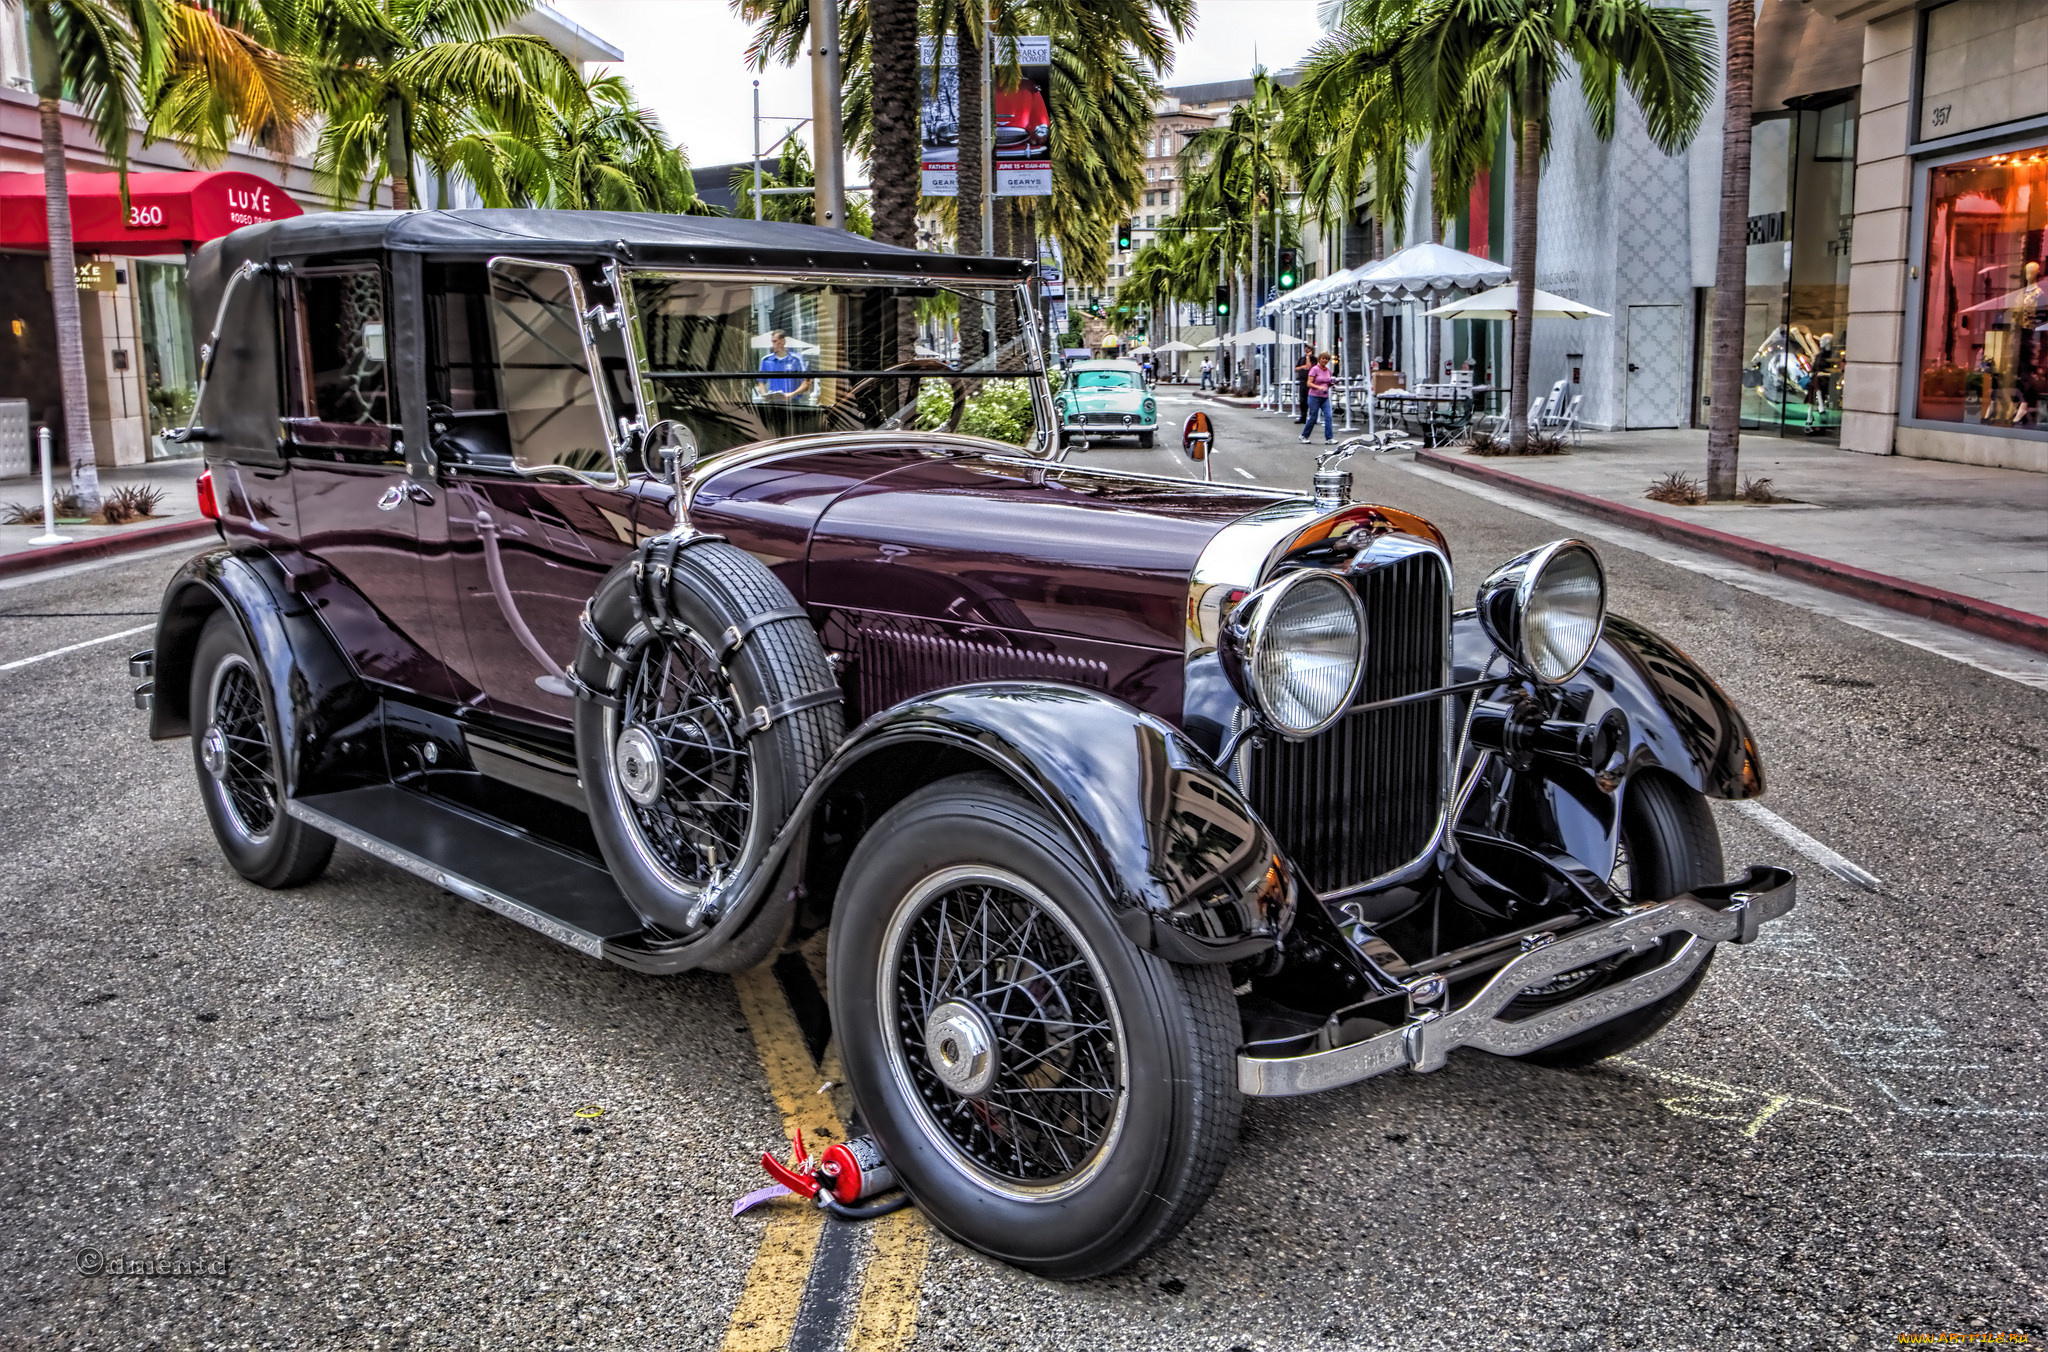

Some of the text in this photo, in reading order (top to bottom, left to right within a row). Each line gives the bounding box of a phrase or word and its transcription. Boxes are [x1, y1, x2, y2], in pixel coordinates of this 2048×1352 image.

[1932, 104, 1952, 127] 357
[228, 186, 271, 213] LUXE
[129, 206, 163, 225] 360
[231, 212, 253, 225] RODEO
[74, 263, 101, 276] XE
